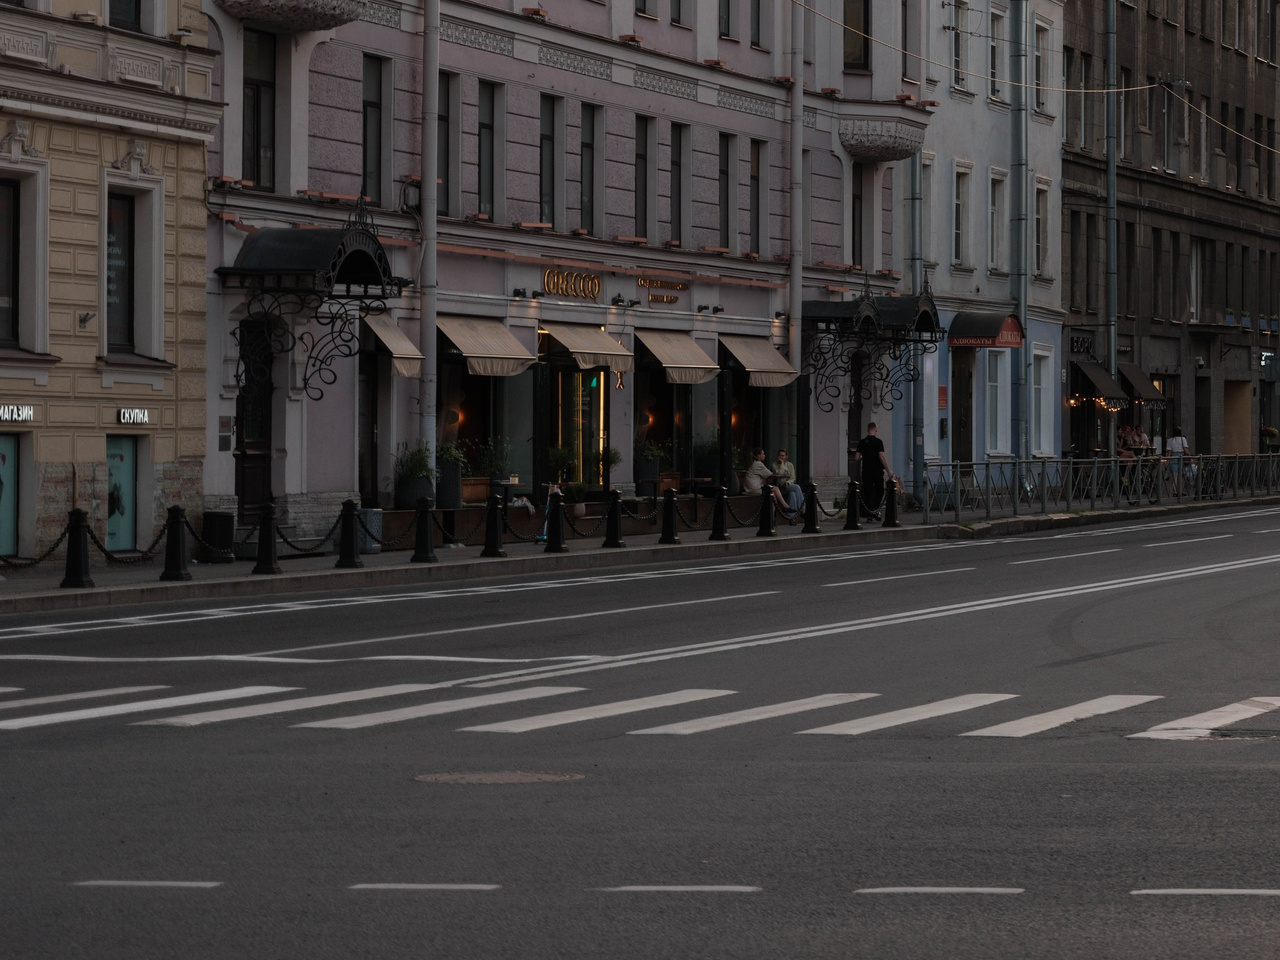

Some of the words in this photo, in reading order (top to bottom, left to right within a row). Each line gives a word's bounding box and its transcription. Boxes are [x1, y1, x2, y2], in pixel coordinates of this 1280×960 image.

[544, 269, 601, 299] GRECCO
[1073, 336, 1094, 353] БЮРО
[120, 408, 149, 424] СКУПКА
